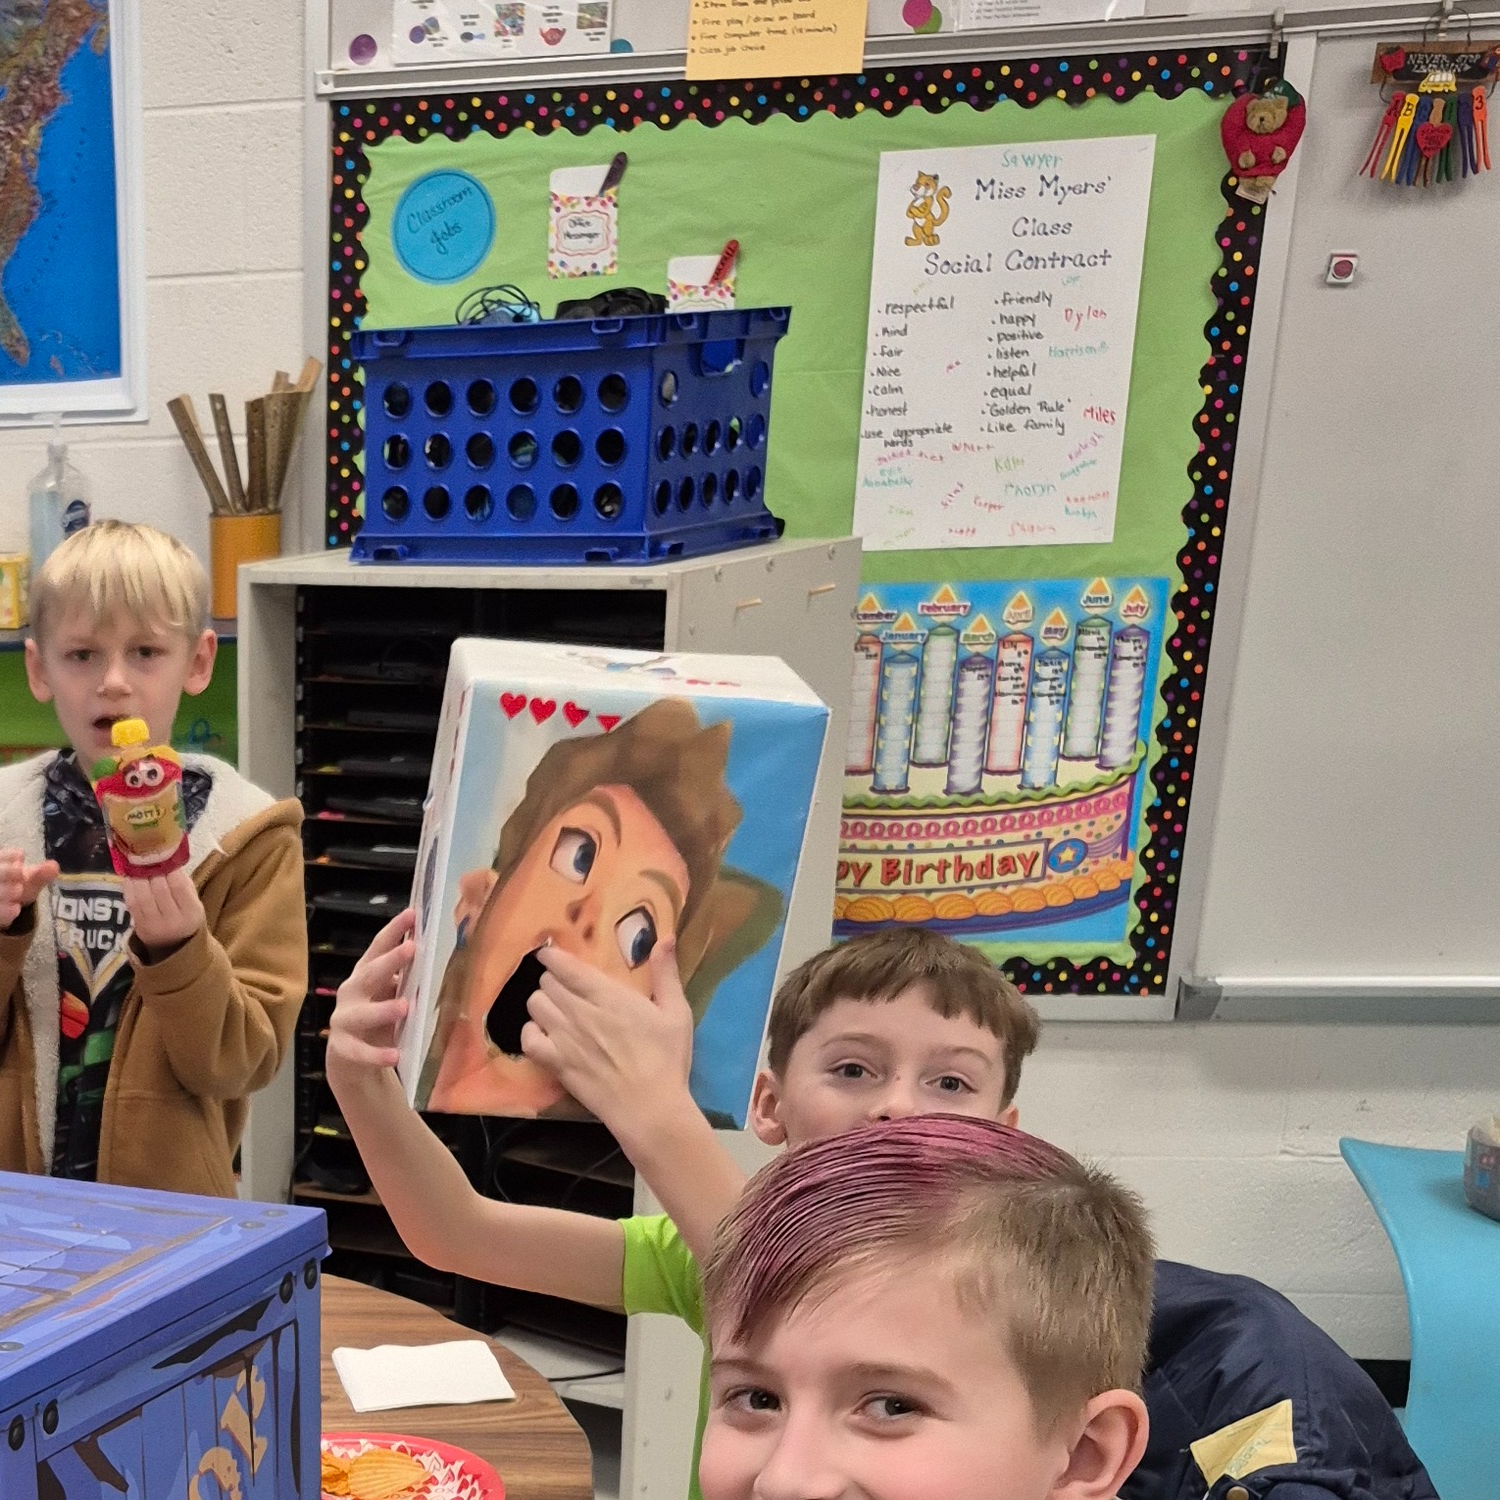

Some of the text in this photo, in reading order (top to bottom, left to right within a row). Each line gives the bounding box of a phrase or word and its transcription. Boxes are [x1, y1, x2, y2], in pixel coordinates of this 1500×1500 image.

[1407, 53, 1450, 65] NEVER
[1403, 101, 1414, 117] B
[1474, 94, 1485, 111] 3
[974, 173, 1113, 206] Miss Myers'
[406, 185, 475, 235] Classroom
[1011, 215, 1074, 238] Class
[923, 248, 1113, 276] Social Contract
[884, 295, 955, 319] respectful
[1001, 290, 1053, 307] friendly
[999, 313, 1037, 328] happy
[996, 330, 1044, 345] positive
[880, 345, 903, 357] fair
[996, 346, 1030, 360] listen
[993, 362, 1037, 382] helpful
[990, 383, 1033, 400] equal
[870, 401, 908, 417] honest
[1083, 406, 1117, 426] Miles
[1024, 417, 1065, 437] family
[918, 601, 971, 616] February
[1082, 594, 1111, 606] June
[856, 610, 898, 622] cember
[1122, 603, 1146, 617] July
[882, 630, 928, 643] January
[880, 850, 1040, 886] Birthday
[52, 895, 128, 925] ONST
